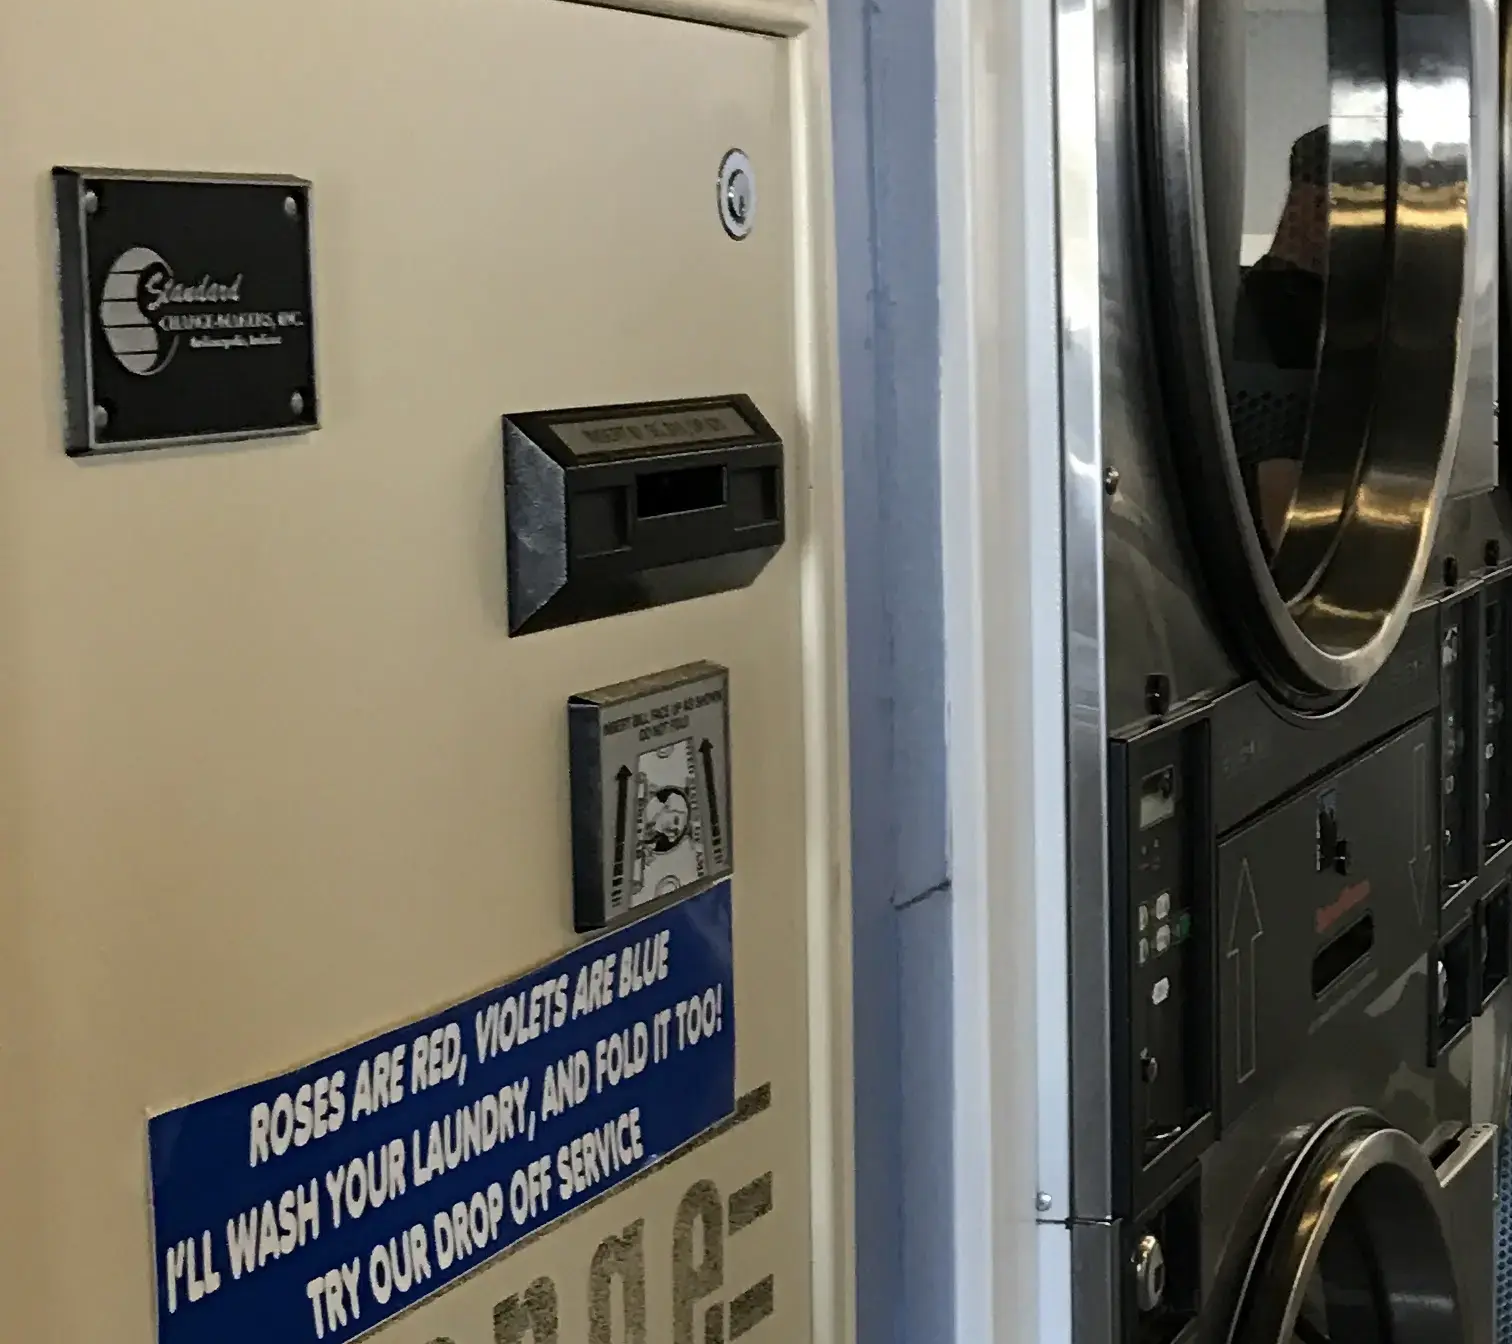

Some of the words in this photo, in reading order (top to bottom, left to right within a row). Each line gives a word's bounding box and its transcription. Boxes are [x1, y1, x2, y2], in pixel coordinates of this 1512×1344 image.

[145, 272, 243, 311] Standard
[166, 1229, 221, 1314] I'LL
[226, 1177, 320, 1279] WASH
[325, 1138, 406, 1229] YOUR
[412, 1076, 536, 1187] LAUNDRY,
[541, 1049, 590, 1122] AND
[596, 1021, 648, 1094] FOLD
[653, 1008, 672, 1063] IT
[675, 983, 723, 1051] TOO!
[250, 1070, 345, 1167] ROSES
[352, 1044, 406, 1121] ARE
[411, 1023, 467, 1086] RED,
[475, 973, 568, 1063] VIOLETS
[572, 953, 616, 1020] ARE
[618, 930, 670, 998] BLUE
[306, 1256, 360, 1339] TRY
[369, 1223, 432, 1304] OUR
[433, 1182, 503, 1270] DROP
[509, 1155, 552, 1226] OFF
[556, 1107, 644, 1200] SERVICE
